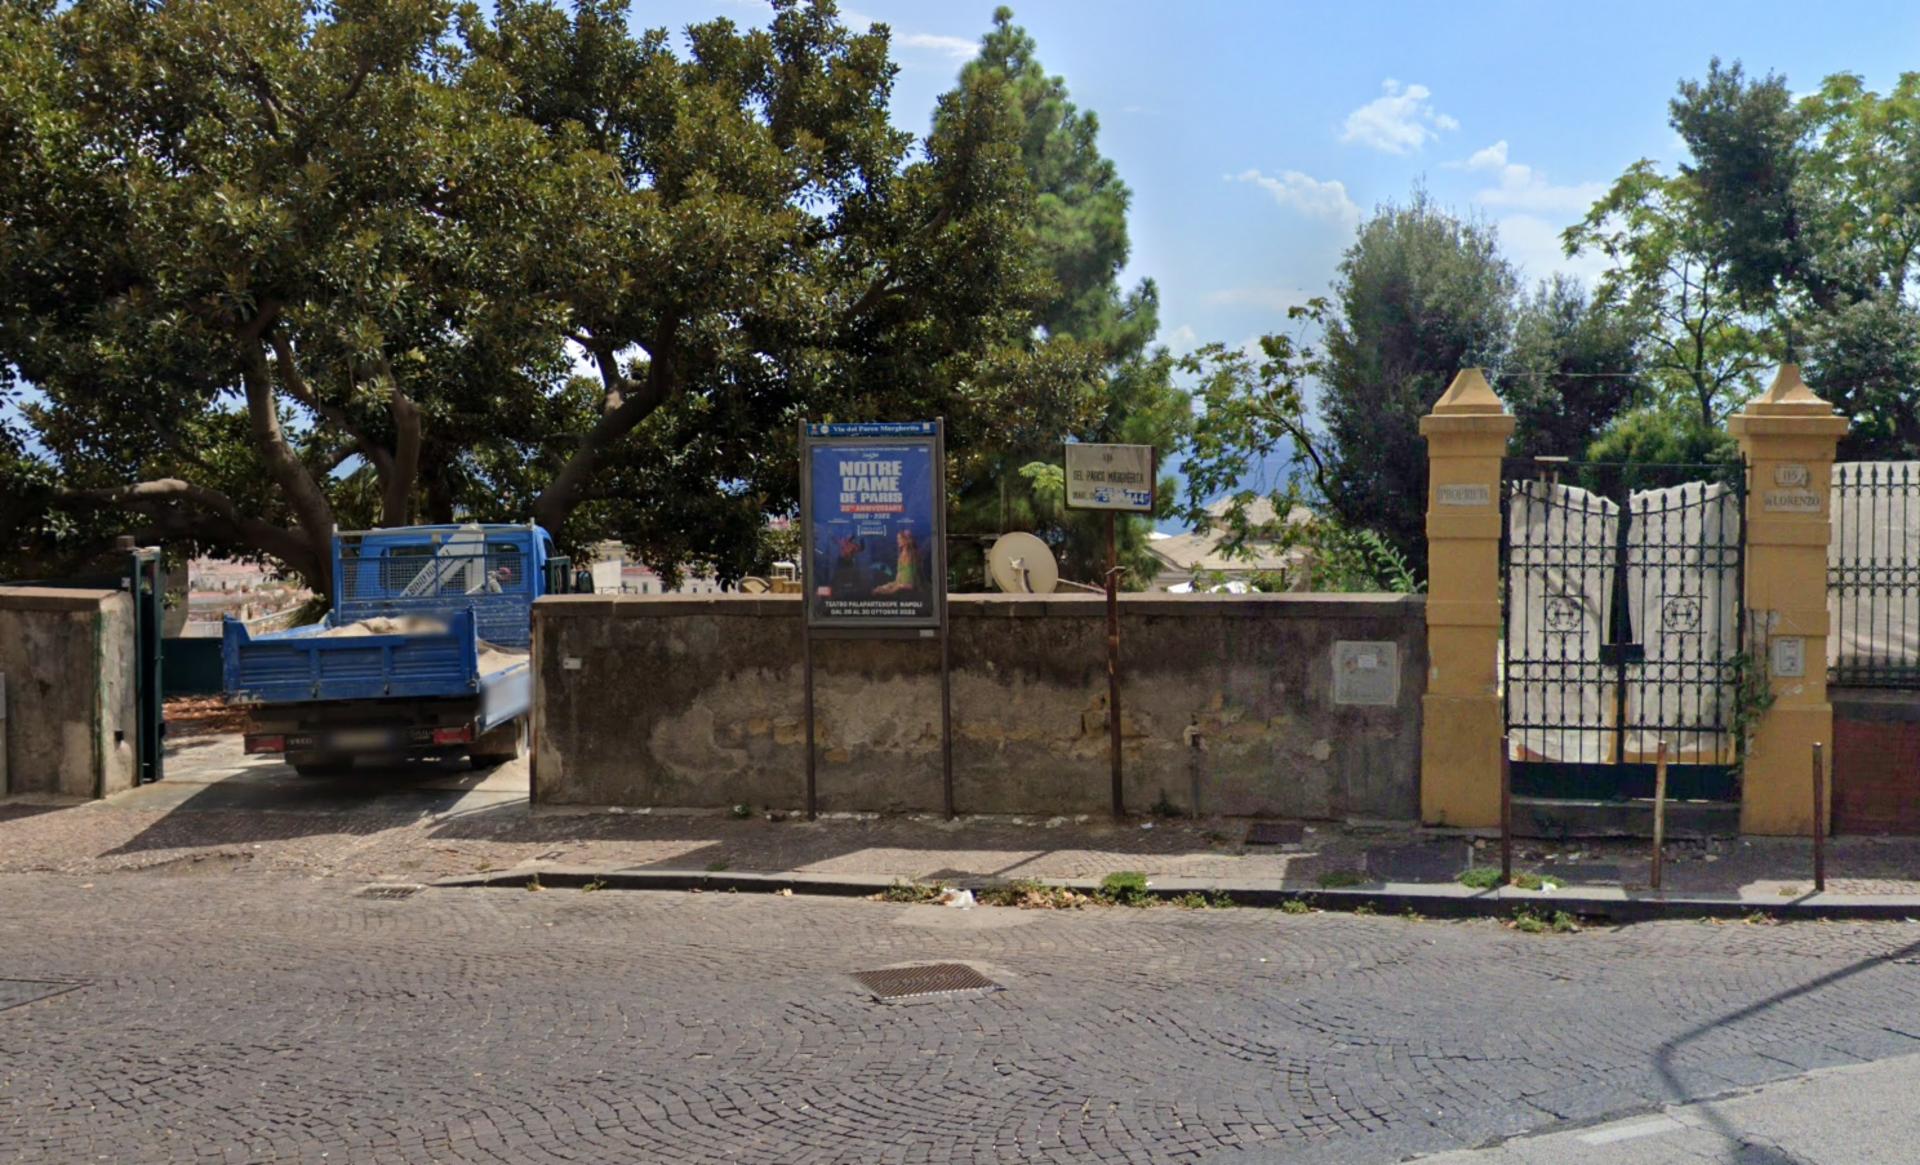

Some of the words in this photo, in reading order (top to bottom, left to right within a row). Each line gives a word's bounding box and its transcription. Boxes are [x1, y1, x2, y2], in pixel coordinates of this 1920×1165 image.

[880, 425, 919, 433] Margherita
[839, 460, 903, 476] NOTRE
[1086, 470, 1105, 481] PARCO
[1107, 471, 1144, 483] MARGHERITA
[843, 477, 899, 491] DAME
[840, 492, 856, 503] DE
[860, 492, 903, 503] PARIS
[1773, 495, 1820, 506] LORENZO
